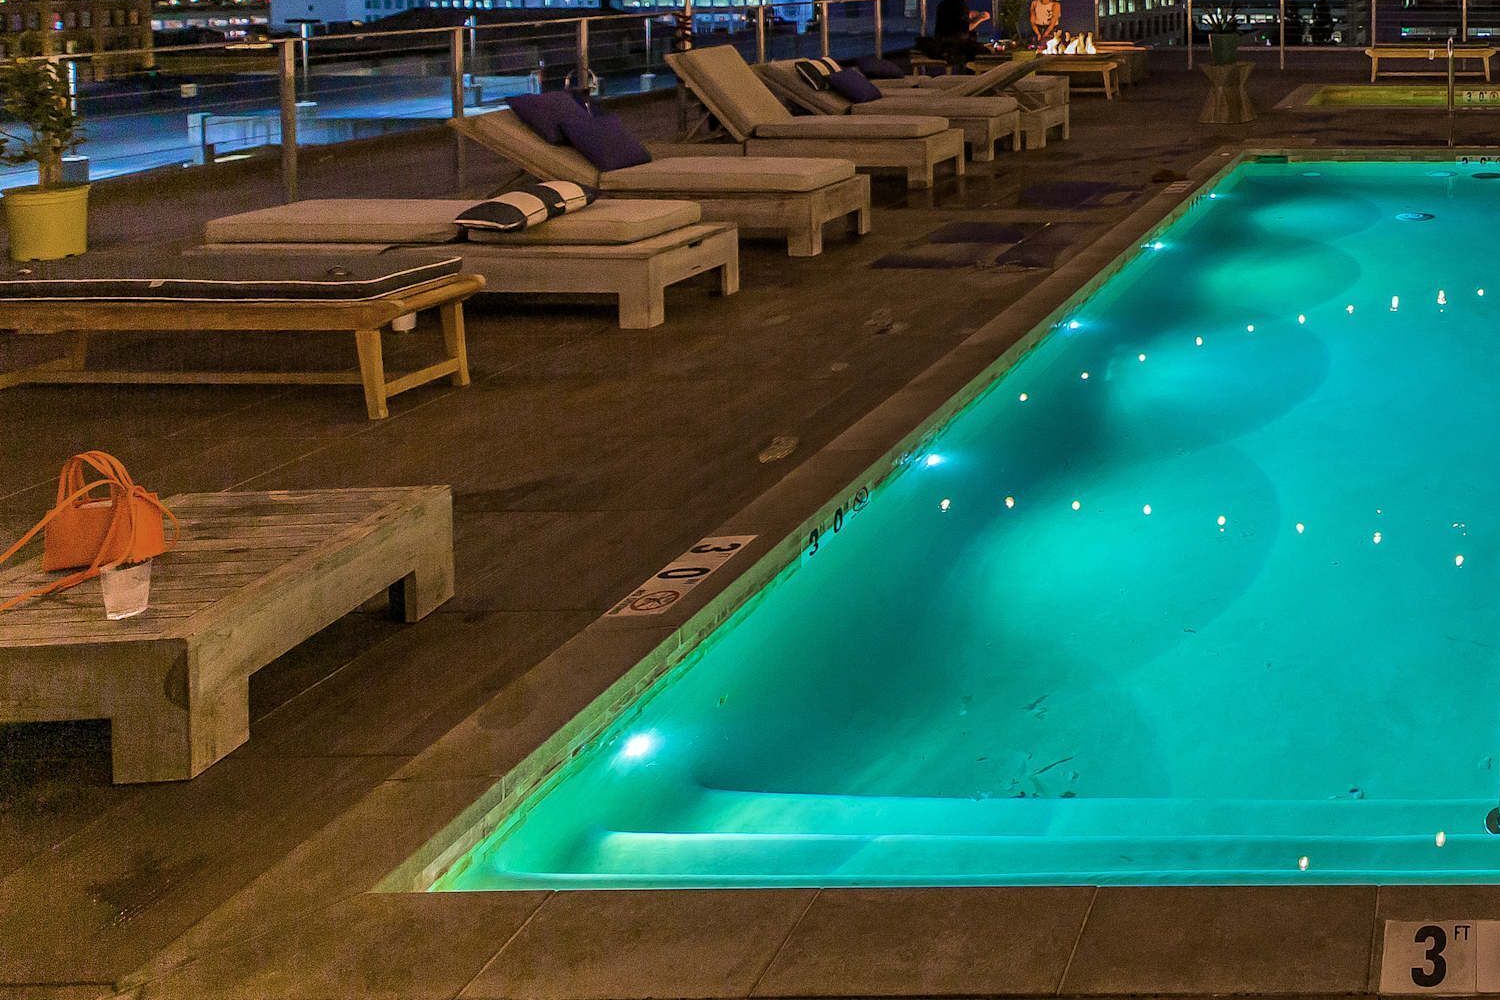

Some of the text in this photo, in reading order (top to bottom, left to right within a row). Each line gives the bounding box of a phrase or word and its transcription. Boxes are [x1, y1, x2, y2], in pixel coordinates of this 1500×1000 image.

[809, 528, 819, 556] 3
[834, 507, 843, 533] 0
[657, 543, 741, 579] 3 0
[1411, 925, 1447, 987] 3
[1454, 925, 1471, 940] FT
